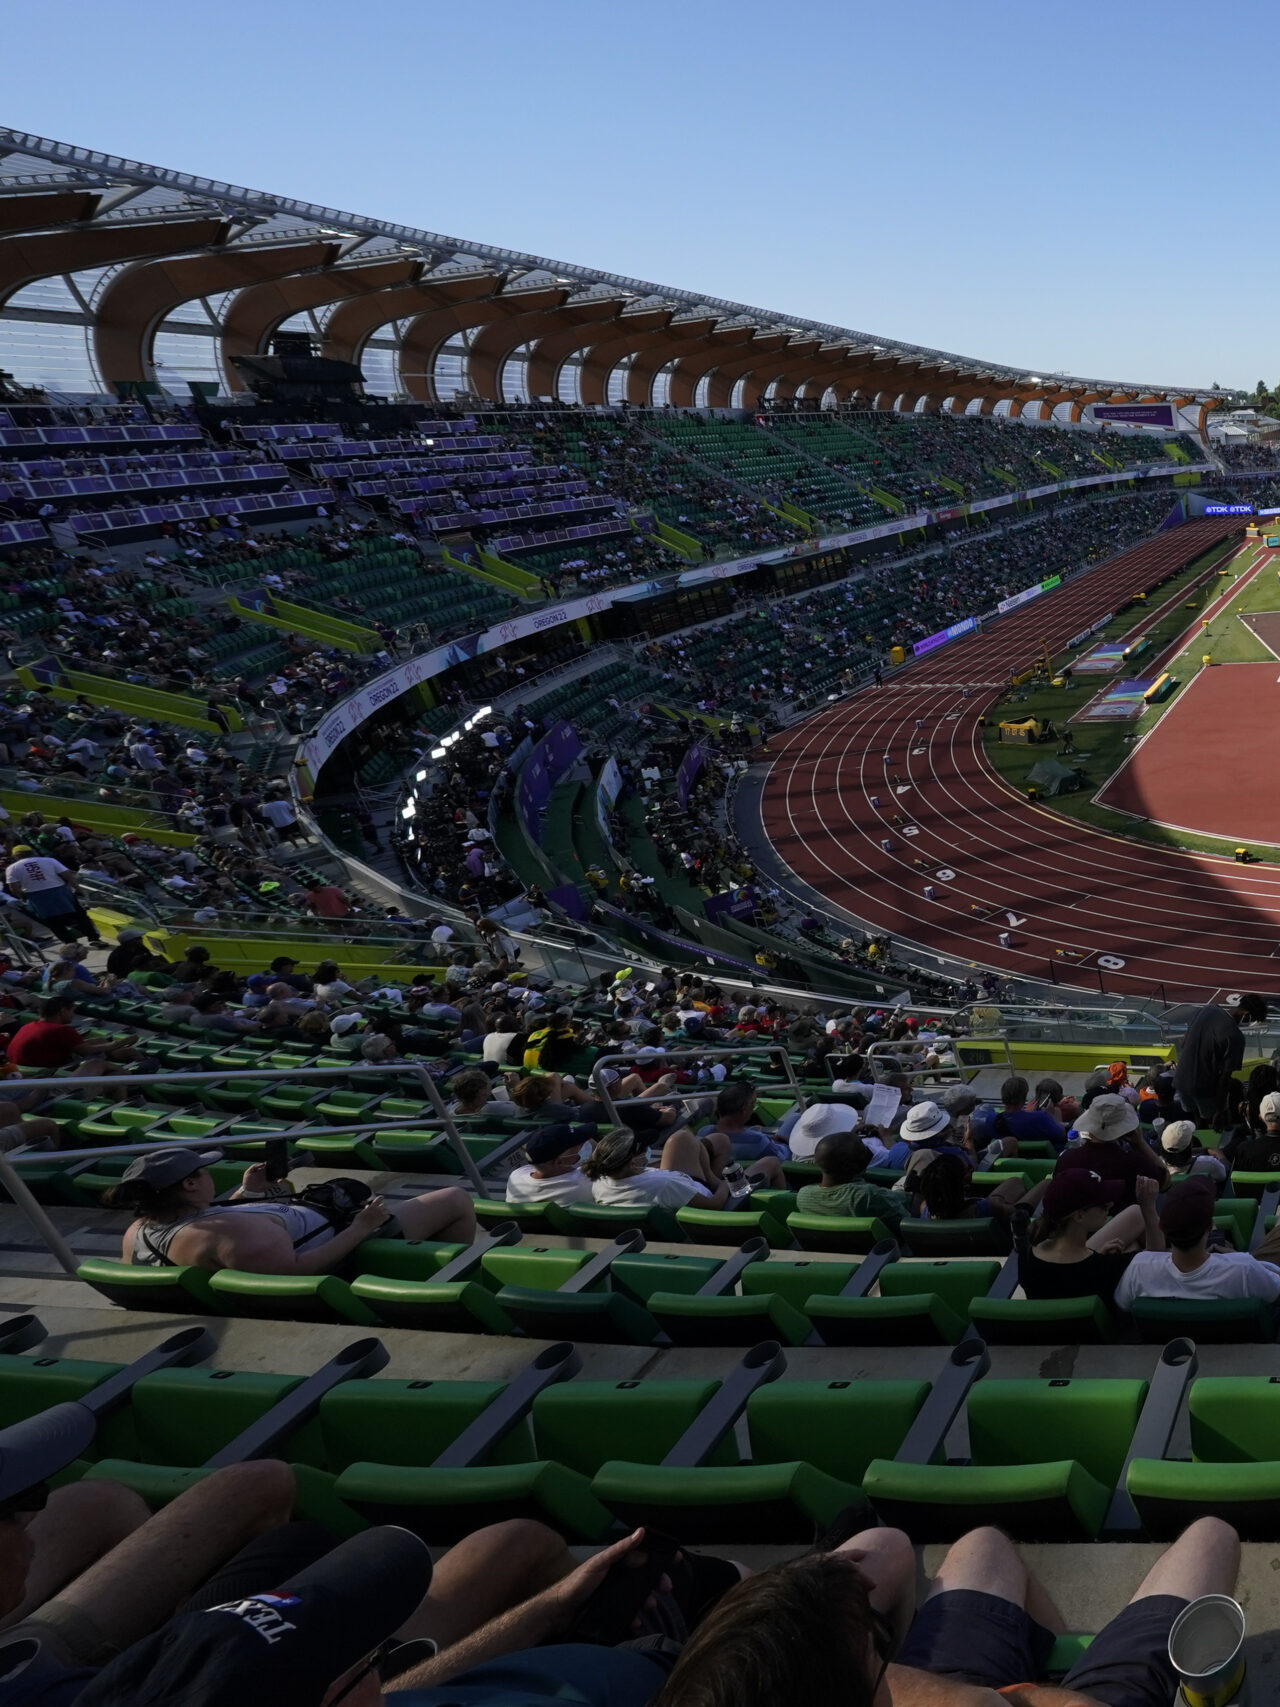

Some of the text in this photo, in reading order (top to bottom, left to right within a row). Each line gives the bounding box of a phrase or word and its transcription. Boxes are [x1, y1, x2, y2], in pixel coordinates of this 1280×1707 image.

[1212, 505, 1228, 513] TDK
[902, 825, 921, 837] 5
[936, 869, 957, 881] 6
[1005, 911, 1028, 927] 7
[1097, 955, 1126, 969] 8
